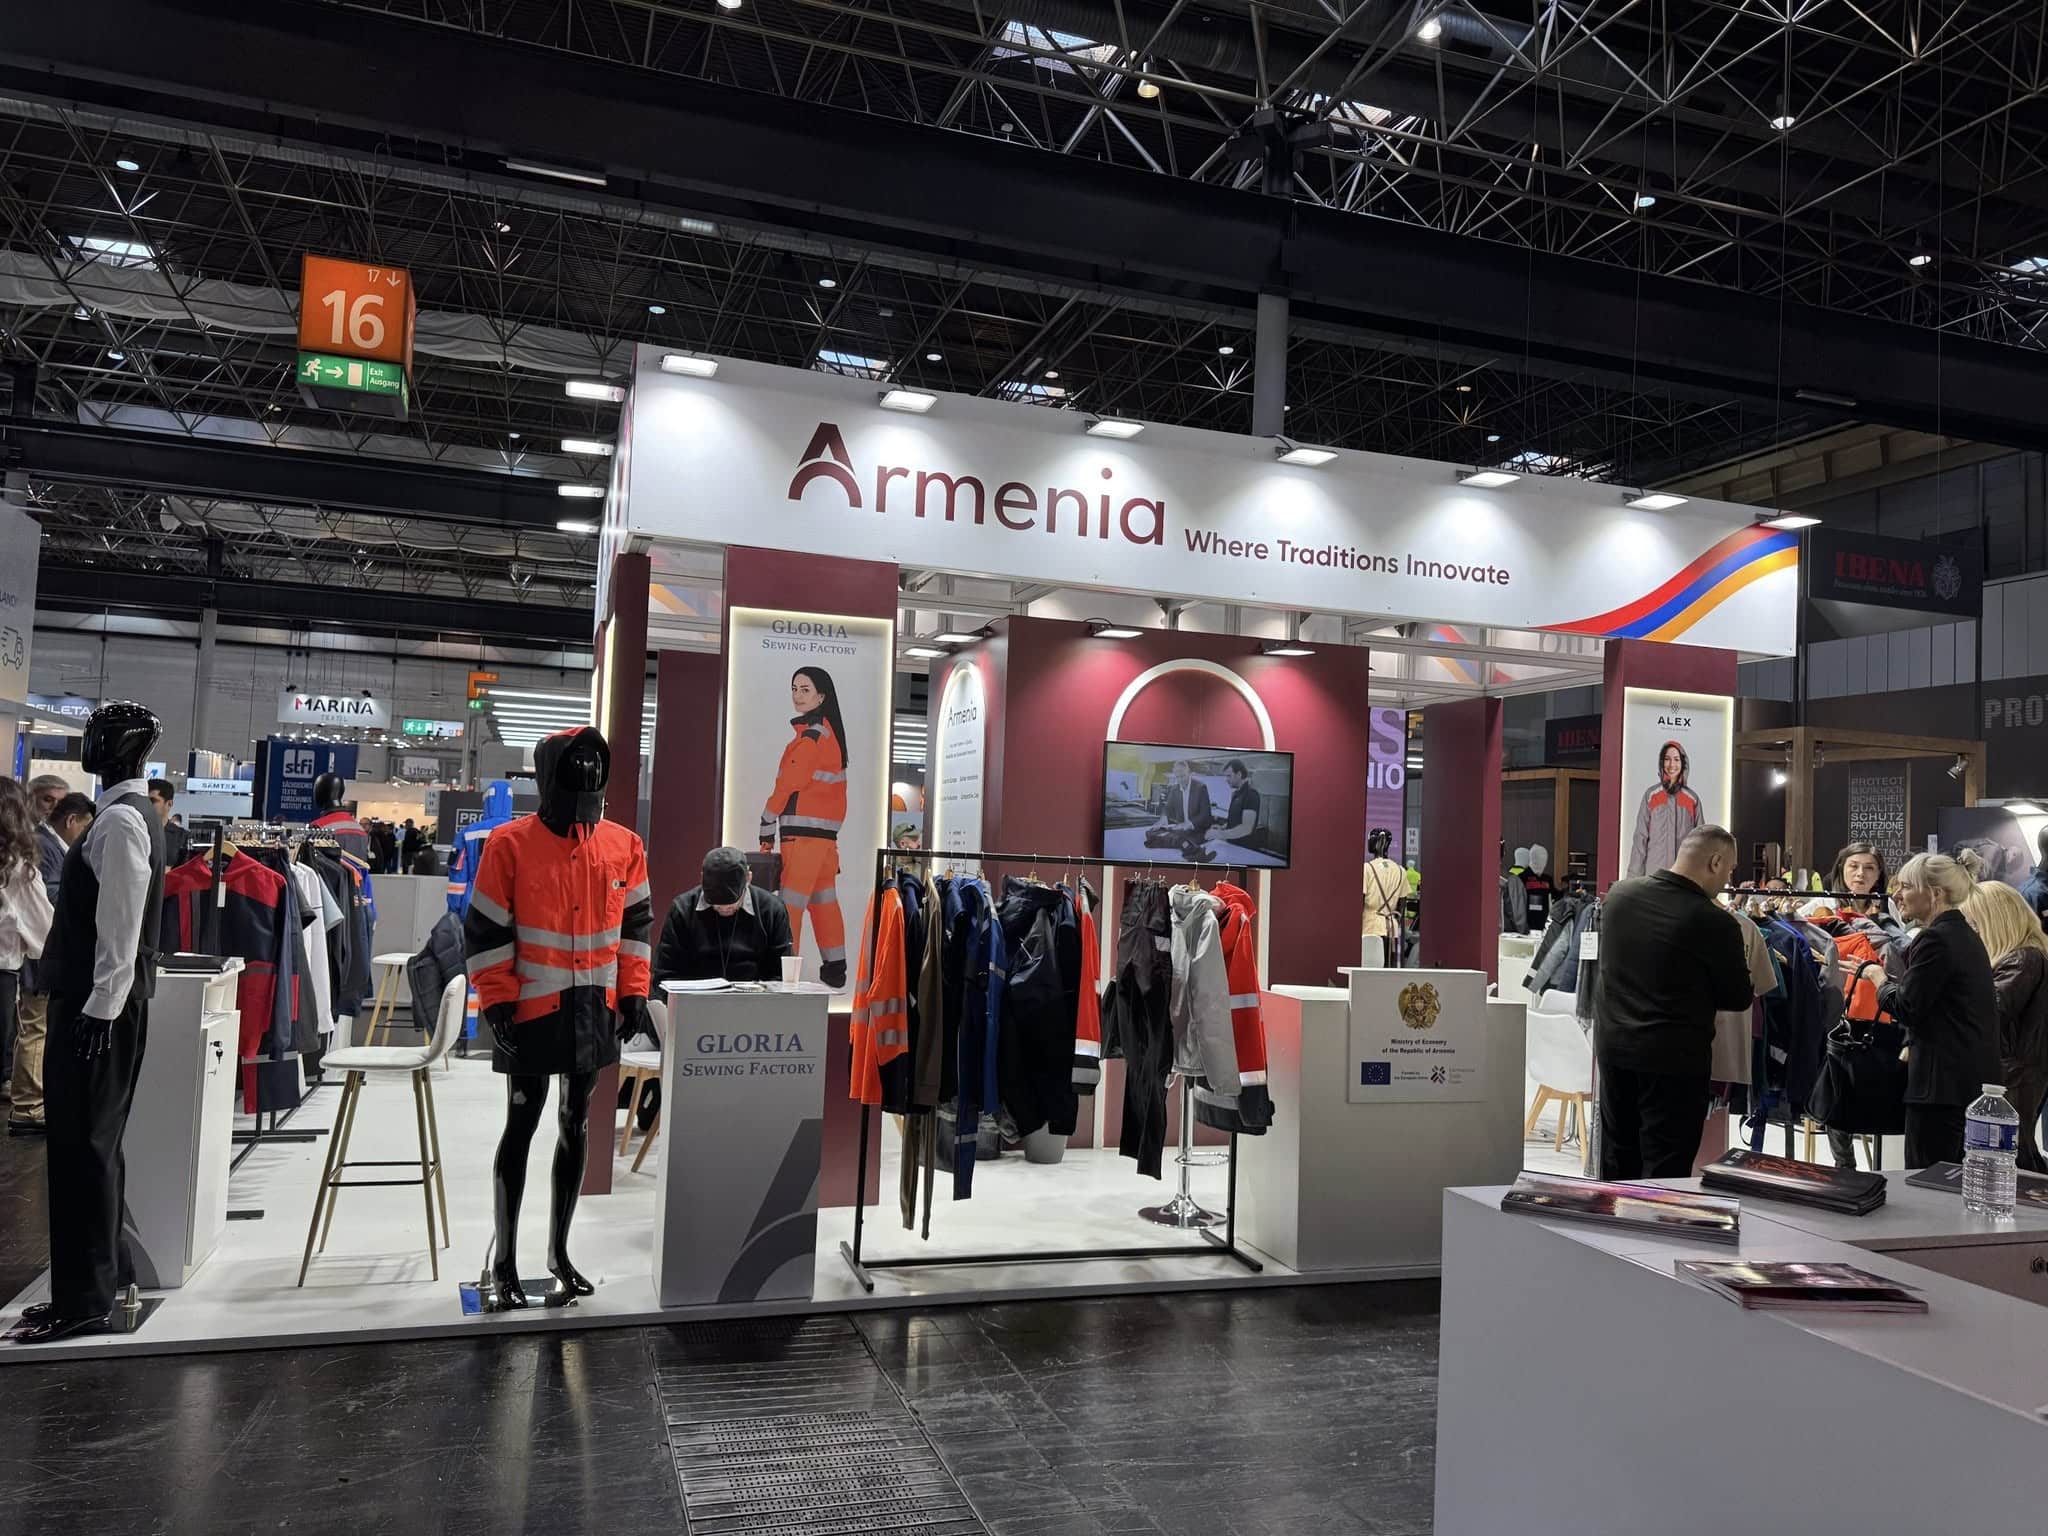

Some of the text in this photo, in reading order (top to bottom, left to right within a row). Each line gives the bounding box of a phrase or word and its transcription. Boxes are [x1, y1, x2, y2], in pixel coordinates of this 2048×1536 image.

[368, 268, 380, 283] 17
[322, 289, 385, 350] 16
[369, 367, 384, 377] Exit
[369, 378, 400, 390] Ausgang
[787, 421, 1165, 545] Armenia
[1184, 528, 1511, 586] Where Traditions Innovate
[771, 619, 848, 639] GLORIA
[295, 697, 374, 716] MARINA
[947, 697, 977, 729] Armenia
[1984, 694, 2048, 729] PRO
[1657, 715, 1692, 727] ALEX
[285, 750, 313, 775] stfi
[1851, 804, 1904, 812] QUALITY
[1851, 812, 1904, 821] SCHUTZ
[1851, 821, 1904, 830] PROTEZIONE
[1851, 830, 1904, 839] SAFETY
[696, 1032, 804, 1054] GLORIA
